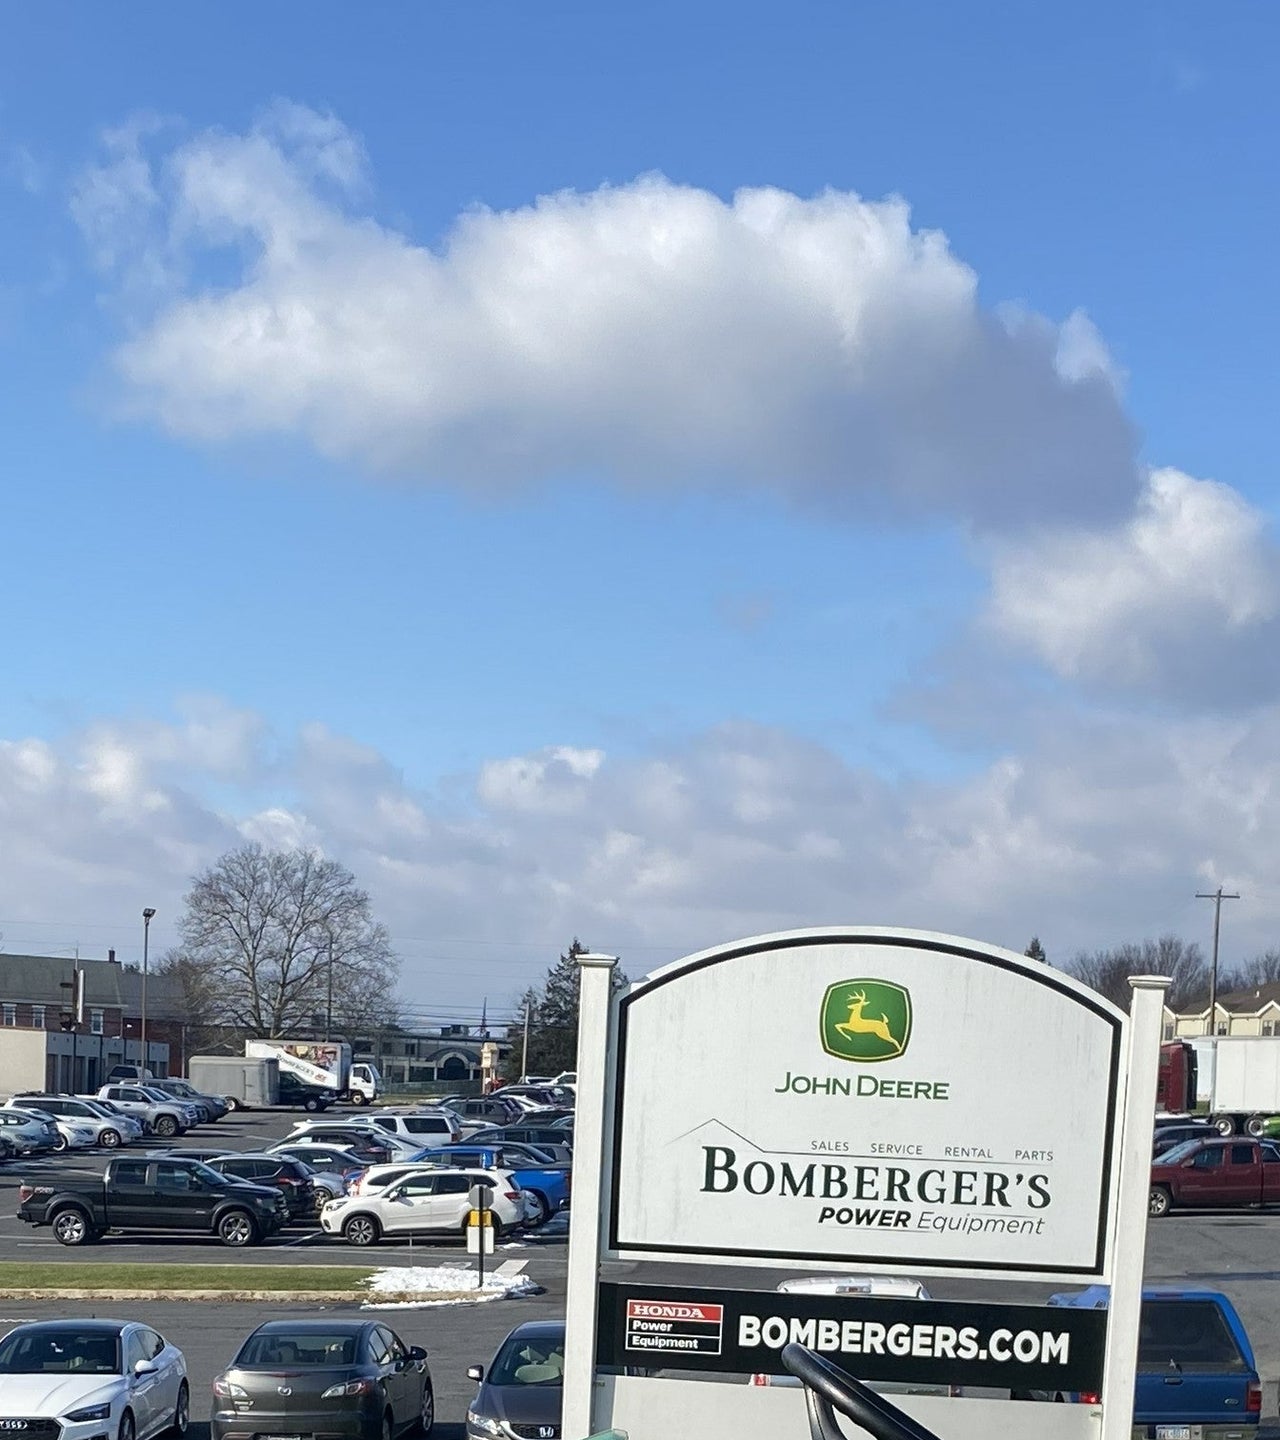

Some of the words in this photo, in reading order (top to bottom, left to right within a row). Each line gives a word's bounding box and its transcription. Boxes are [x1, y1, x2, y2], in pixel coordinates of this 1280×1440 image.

[775, 1072, 851, 1097] JOHN
[857, 1075, 950, 1100] DEERE
[811, 1140, 850, 1153] SALES
[870, 1143, 923, 1156] SERVICE
[944, 1146, 994, 1159] RENTAL
[1015, 1149, 1054, 1162] PARTS
[699, 1146, 1052, 1210] BOMBERGER'S
[818, 1207, 912, 1228] POWER
[917, 1211, 1046, 1236] Equipment
[633, 1304, 706, 1319] HONDA
[632, 1320, 673, 1332] Power
[631, 1335, 699, 1349] Equipment
[738, 1315, 1070, 1365] BOMBERGERS.COM
